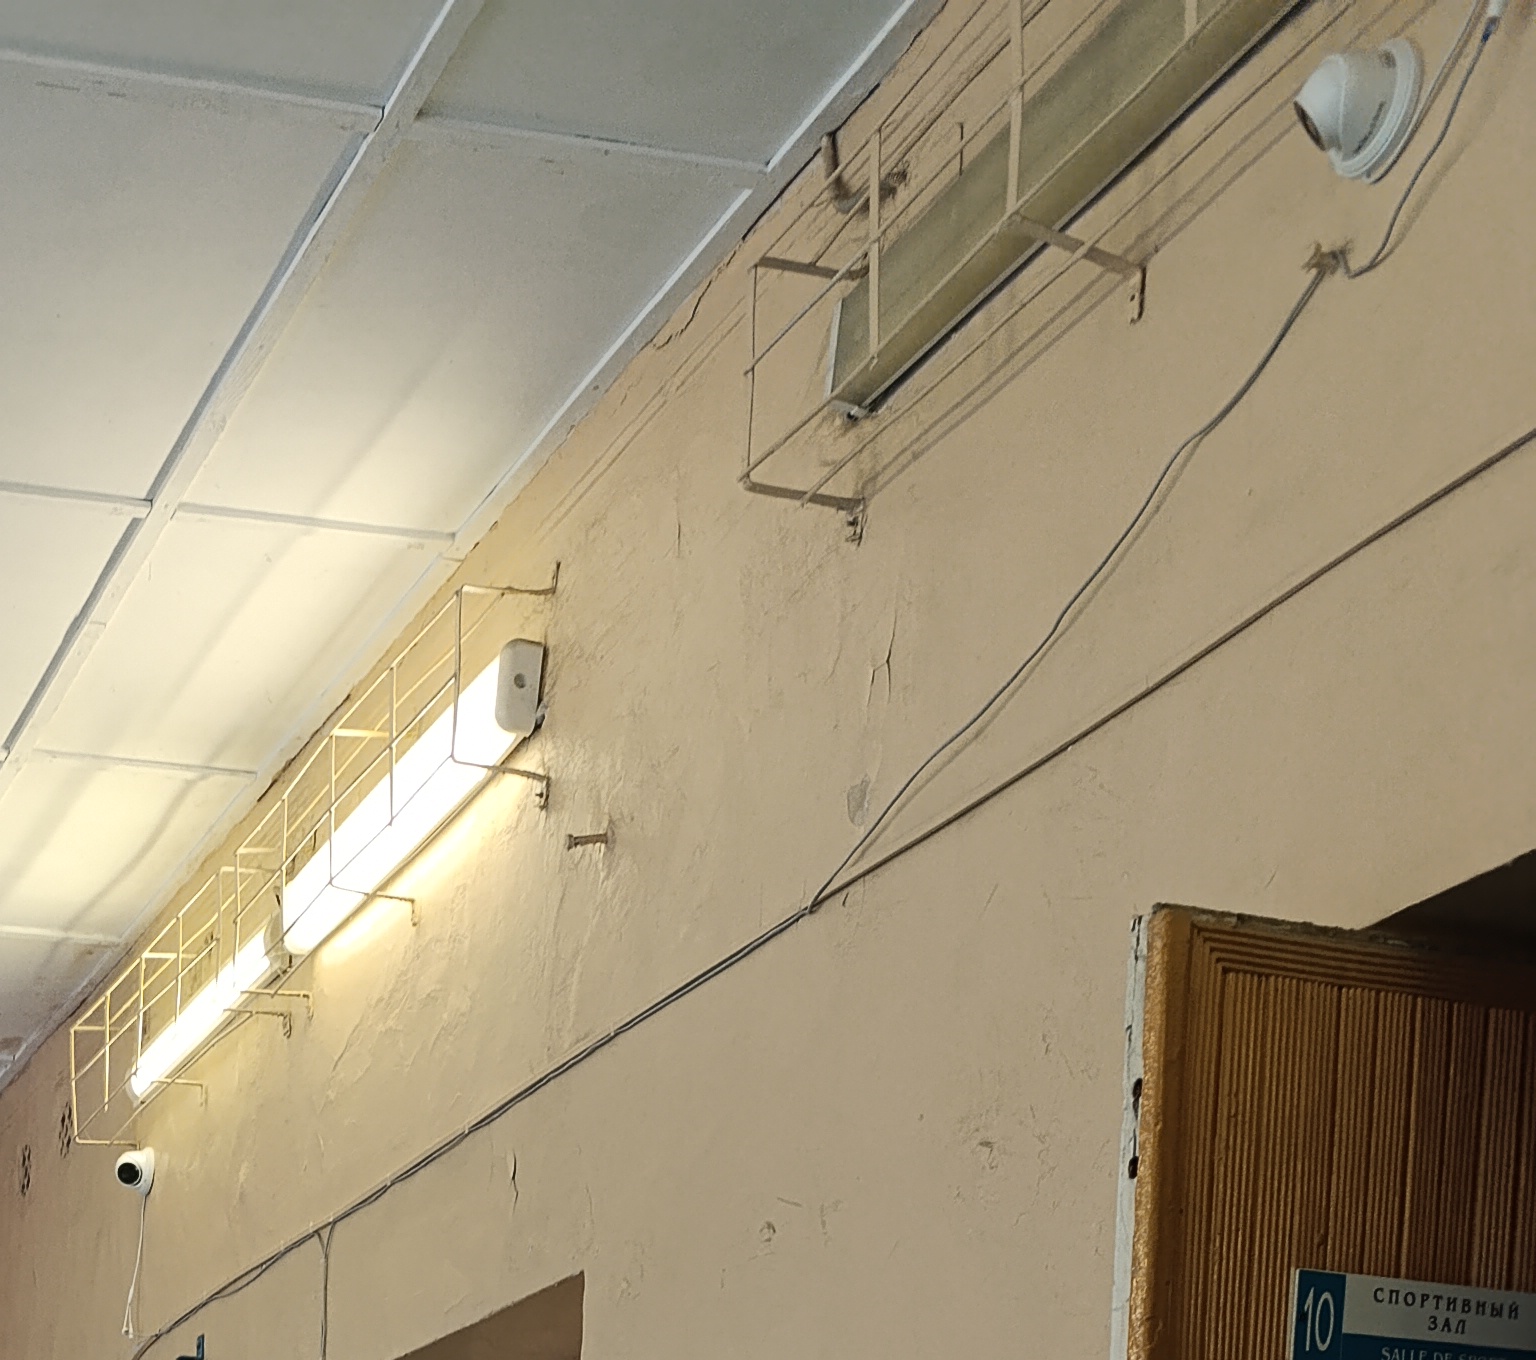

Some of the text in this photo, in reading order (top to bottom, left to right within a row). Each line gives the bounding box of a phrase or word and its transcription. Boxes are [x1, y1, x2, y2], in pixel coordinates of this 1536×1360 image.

[1304, 1286, 1334, 1352] 10
[1373, 1287, 1520, 1320] СПОРТИВНЫЙ
[1427, 1315, 1466, 1335] ЗАЛ
